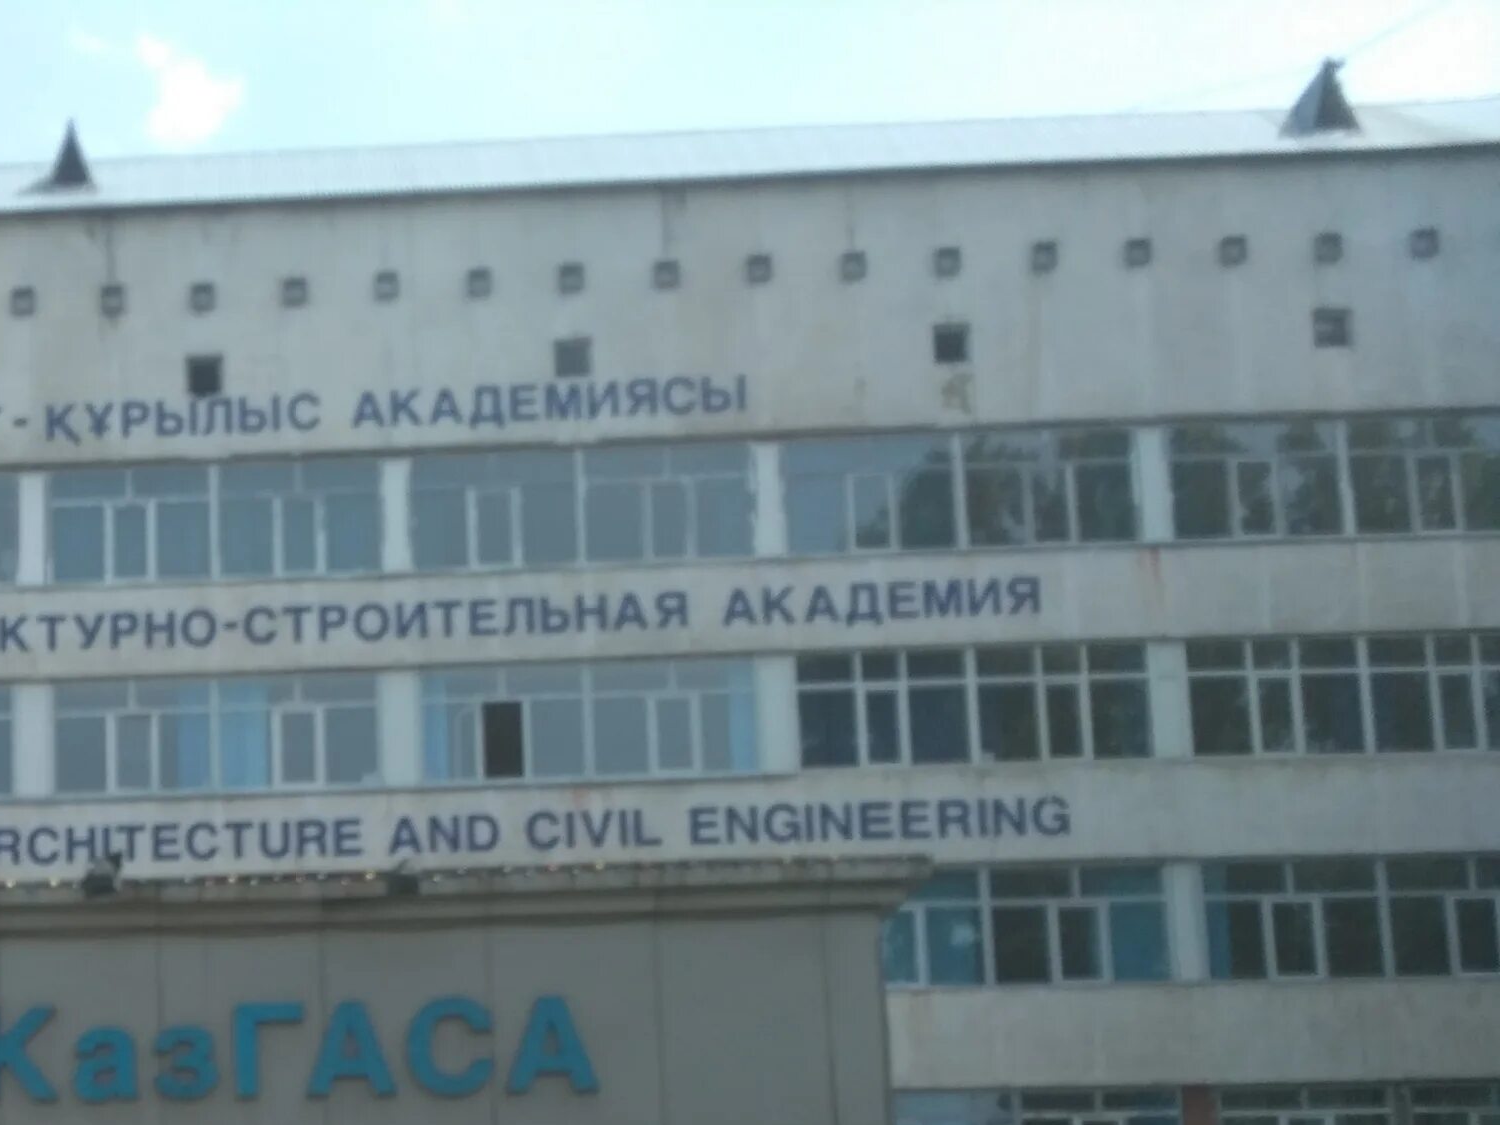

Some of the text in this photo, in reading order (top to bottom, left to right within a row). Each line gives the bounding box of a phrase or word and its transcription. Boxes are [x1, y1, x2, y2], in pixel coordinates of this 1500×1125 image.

[352, 375, 747, 426] АКАДЕМИЯСЫ
[723, 576, 1041, 627] АКАДЕМИЯ
[389, 814, 500, 855] AND
[525, 809, 663, 852] CIVIL
[690, 796, 1071, 845] ENGINEERING
